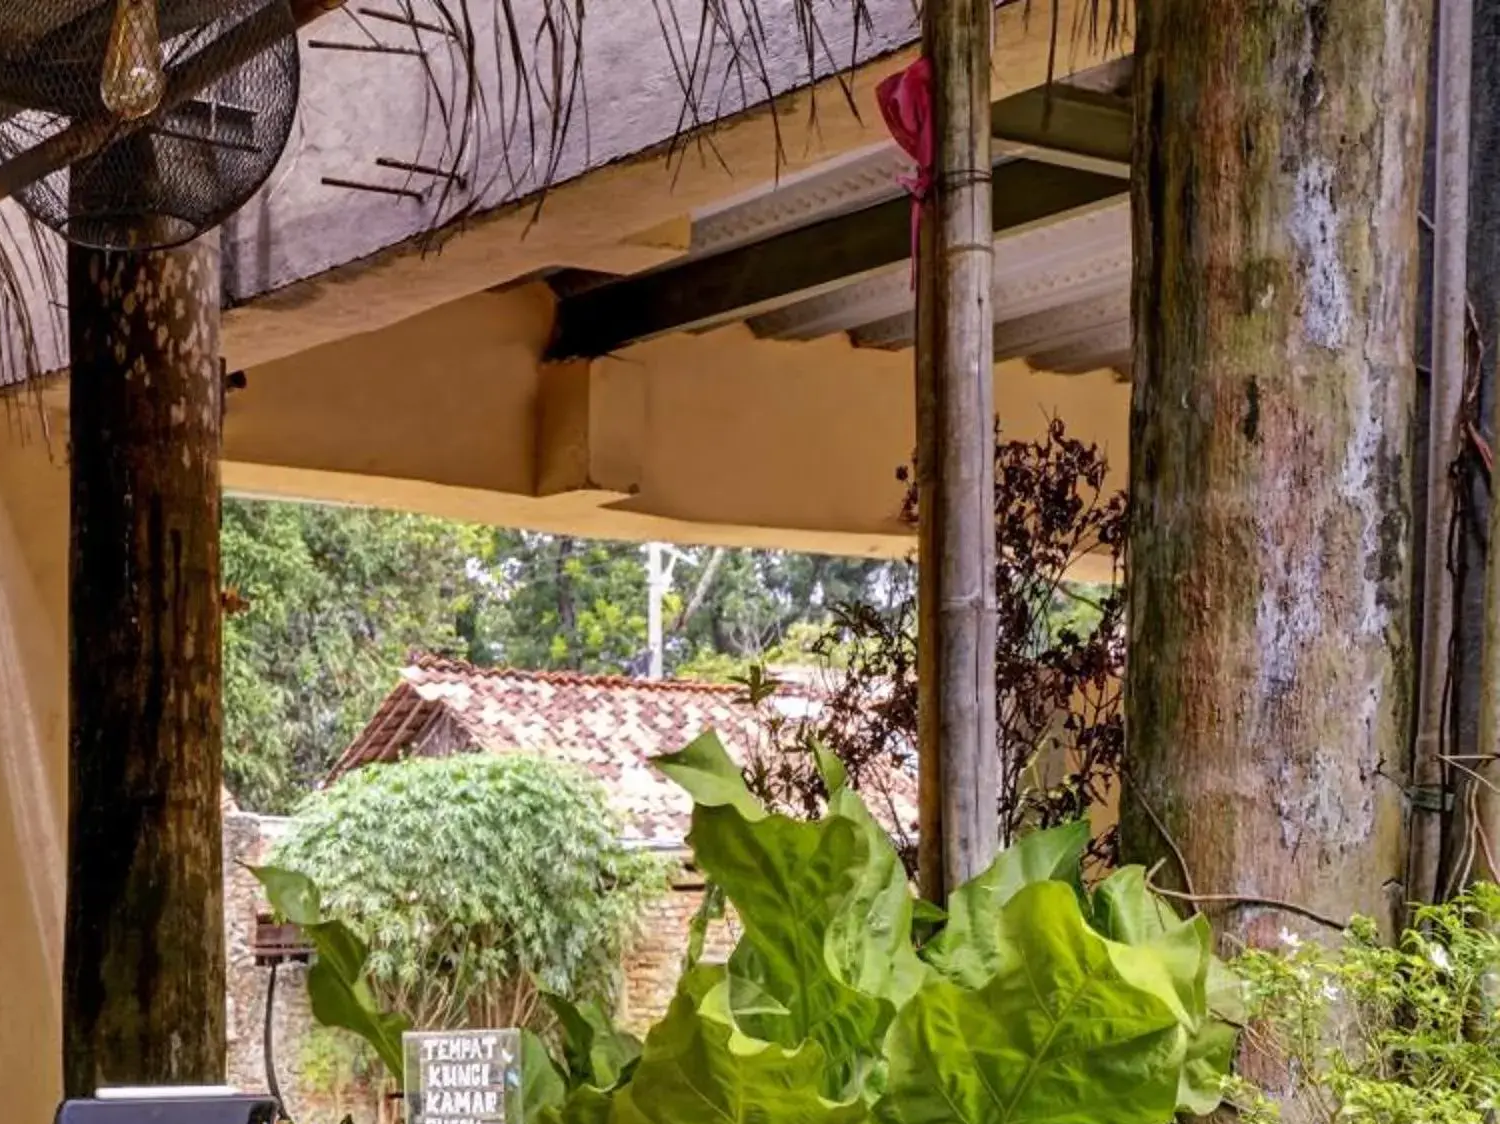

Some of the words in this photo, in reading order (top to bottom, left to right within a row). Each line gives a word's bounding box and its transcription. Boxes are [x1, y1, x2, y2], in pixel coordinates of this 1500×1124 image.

[423, 1036, 497, 1060] TEMPAT
[428, 1063, 490, 1086] KUNCI
[426, 1091, 497, 1113] KAMAR
